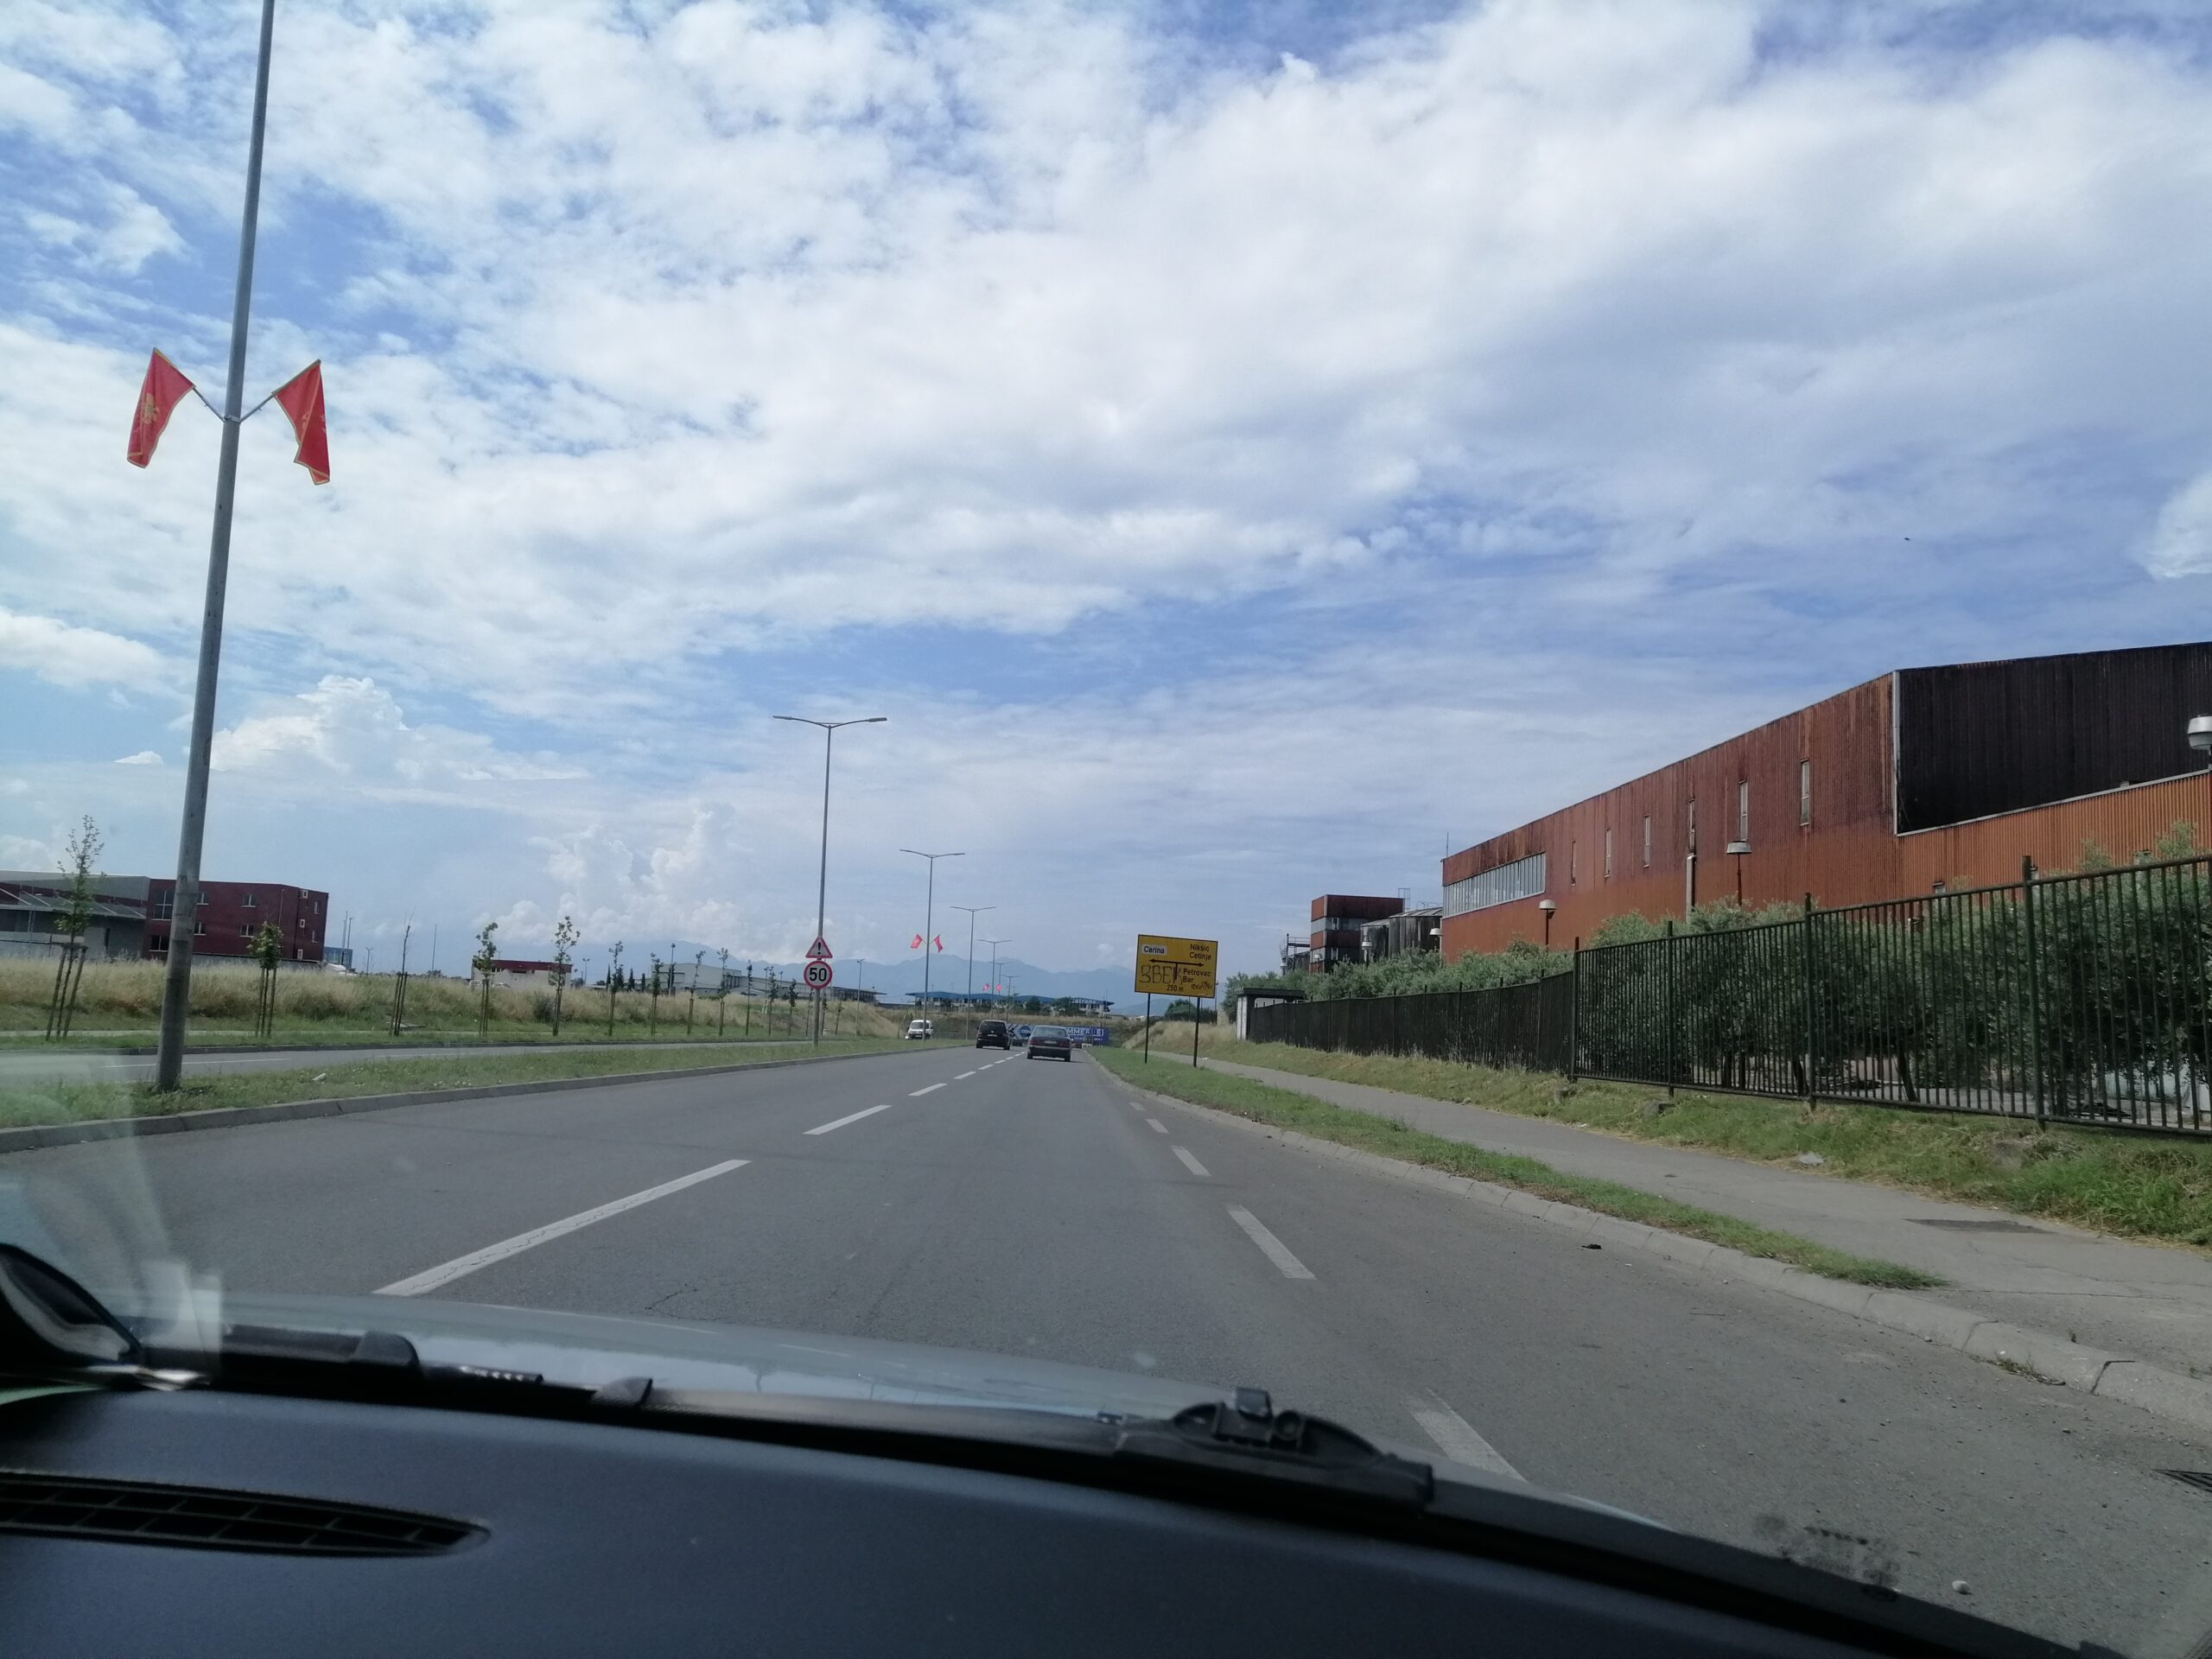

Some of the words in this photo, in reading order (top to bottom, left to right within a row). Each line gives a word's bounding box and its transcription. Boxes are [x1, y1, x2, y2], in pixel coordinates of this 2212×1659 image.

[1144, 945, 1165, 954] Carina
[1189, 952, 1211, 961] Cetinje
[809, 967, 827, 982] 50
[1183, 969, 1211, 977] Petrovac
